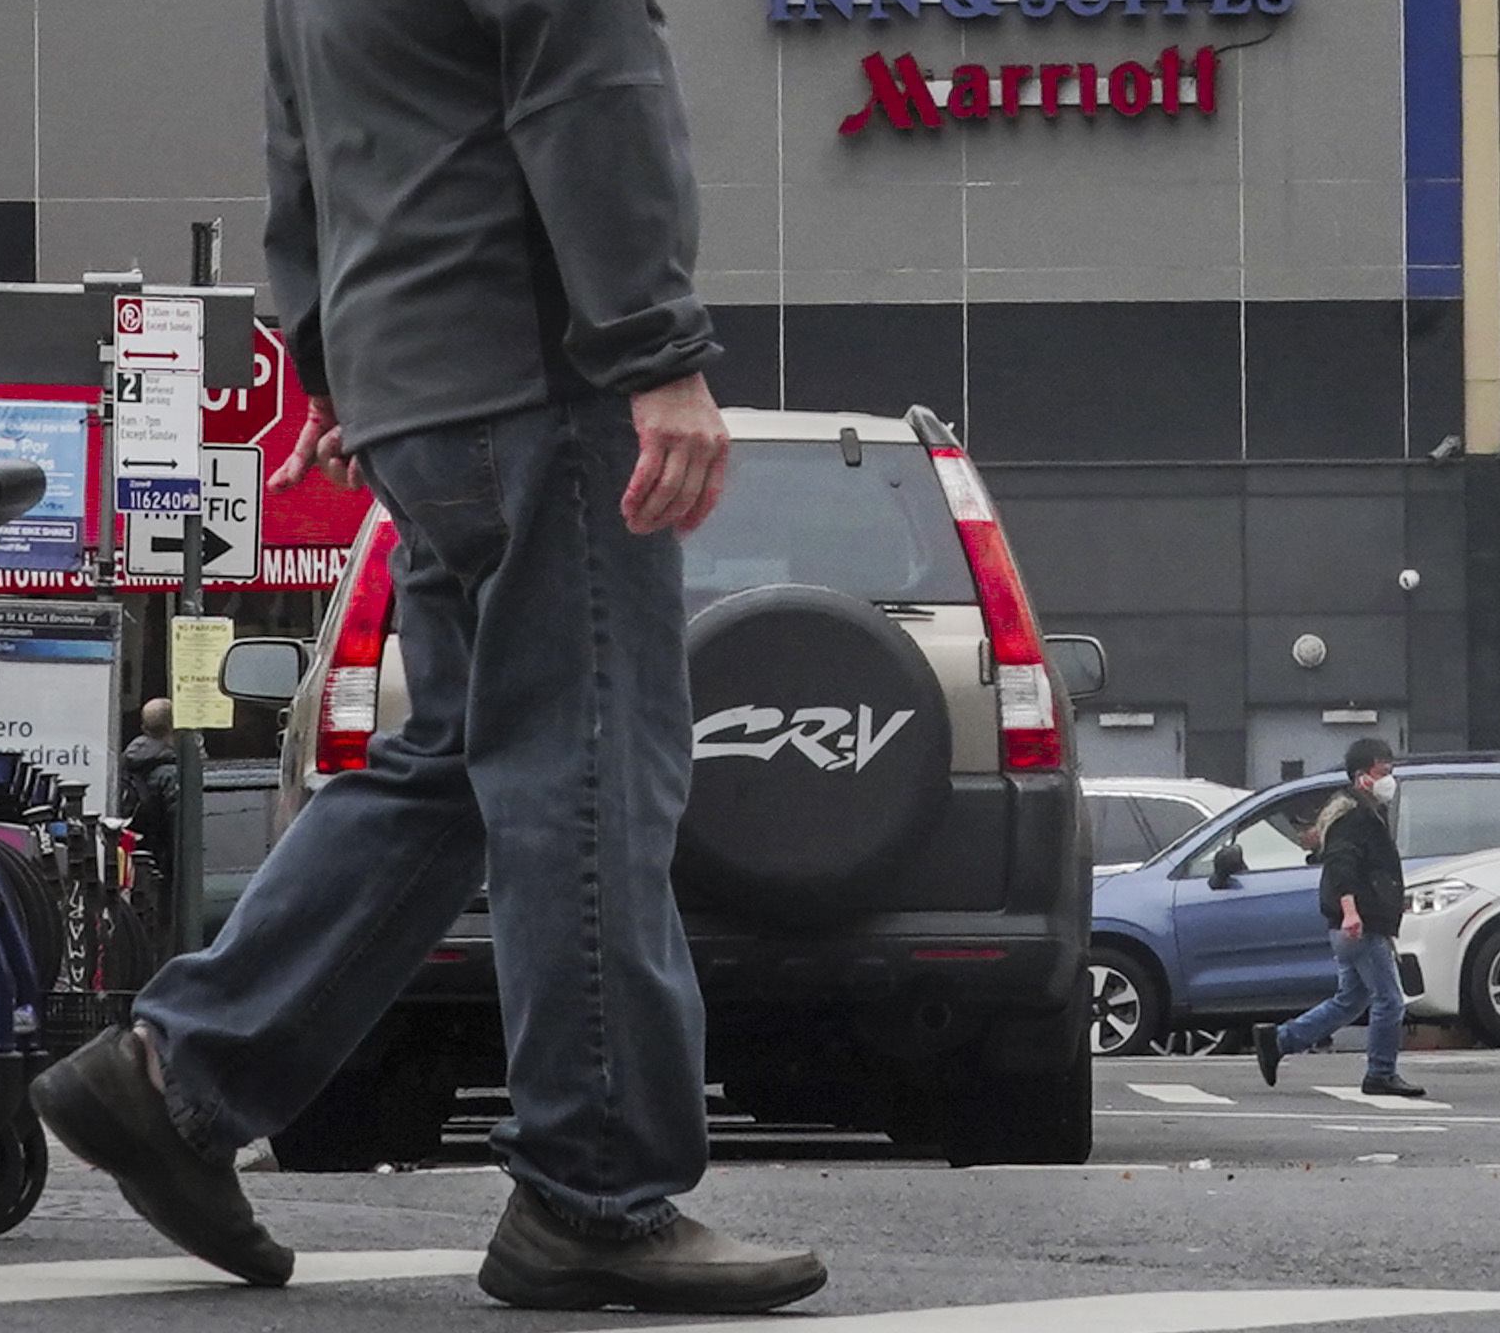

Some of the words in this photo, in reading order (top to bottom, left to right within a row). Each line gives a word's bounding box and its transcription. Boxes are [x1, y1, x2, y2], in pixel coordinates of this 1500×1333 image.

[837, 44, 1221, 135] Marriott
[169, 321, 193, 332] Sunday
[121, 373, 137, 401] 2
[120, 427, 148, 441] Except
[149, 428, 178, 442] Sunday
[130, 491, 182, 510] 116240
